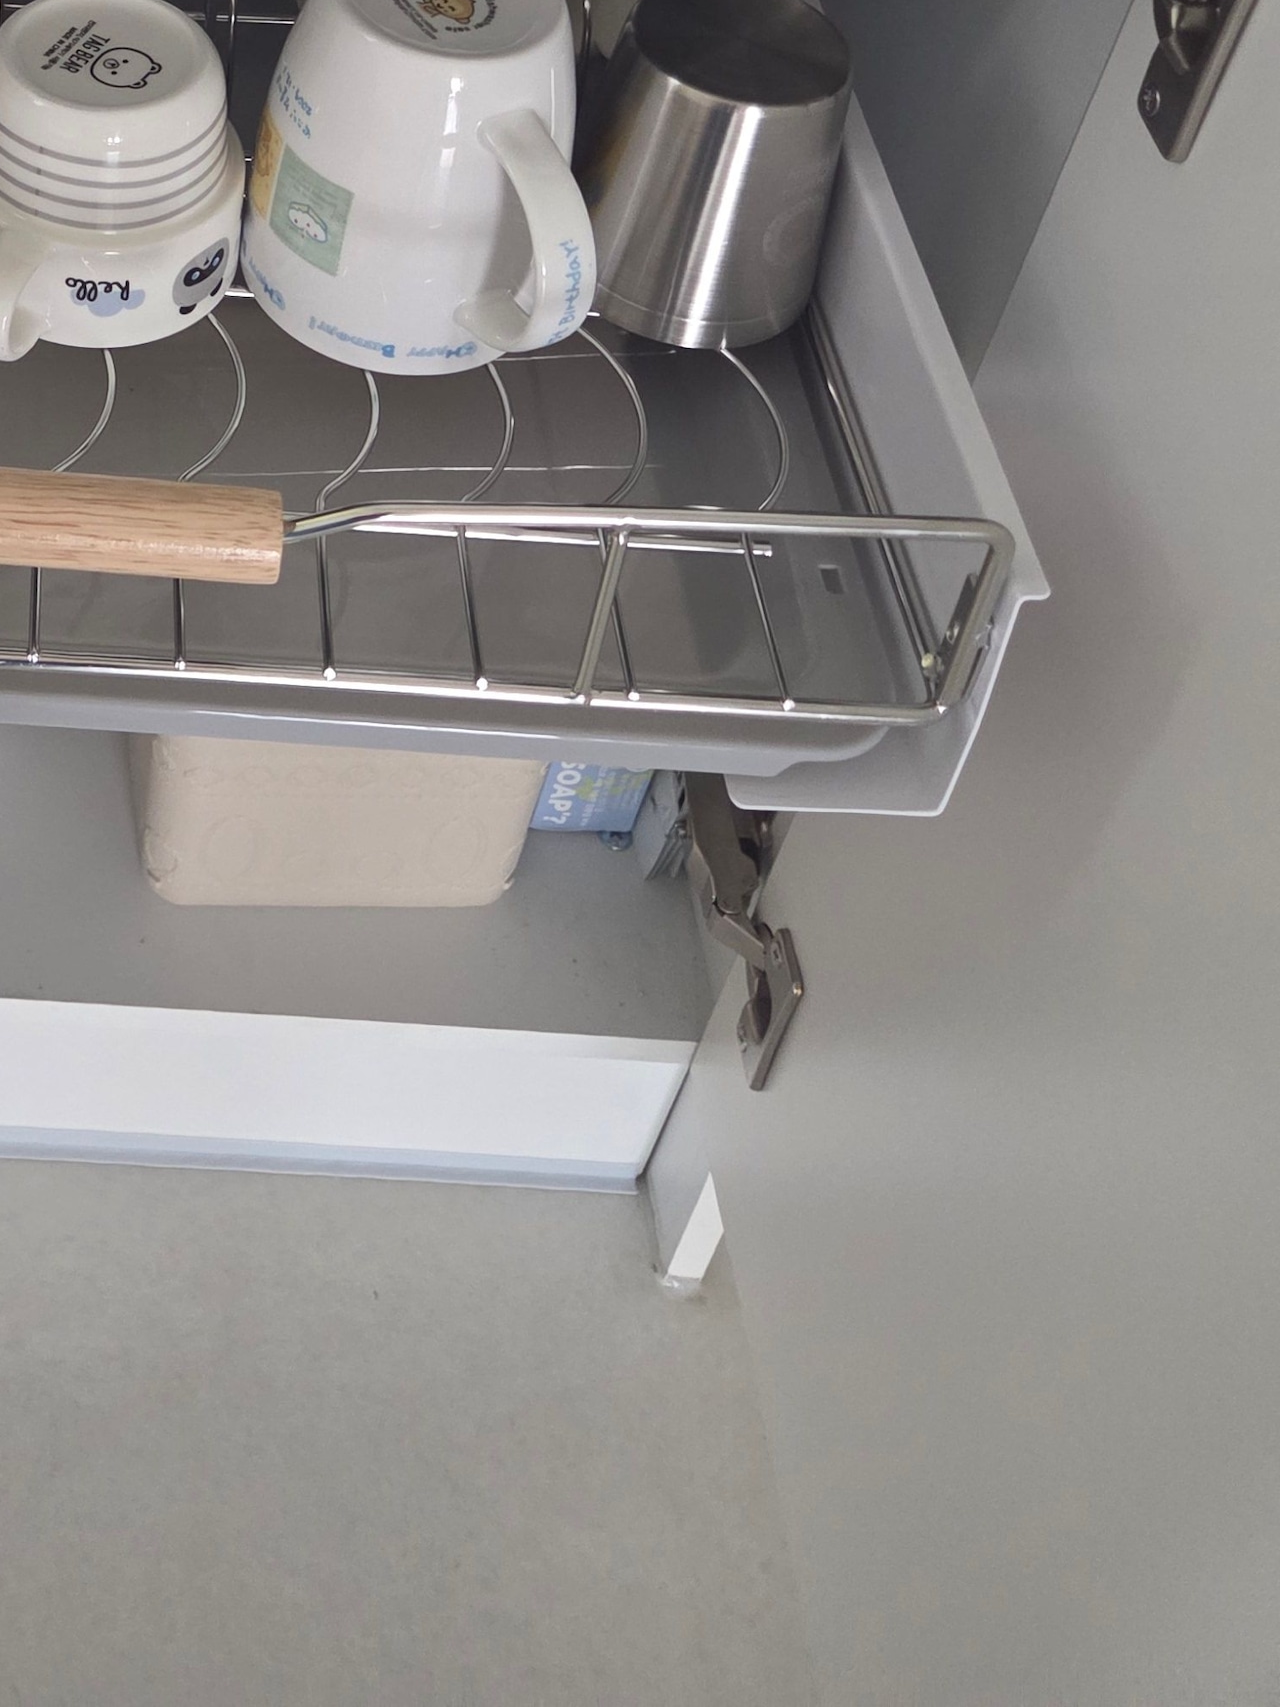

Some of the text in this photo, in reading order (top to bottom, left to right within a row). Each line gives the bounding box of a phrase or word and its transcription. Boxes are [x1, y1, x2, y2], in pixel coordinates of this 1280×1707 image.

[82, 34, 111, 53] TAG
[59, 49, 95, 74] BEAR
[65, 277, 130, 301] hello
[558, 239, 583, 328] Birthday!
